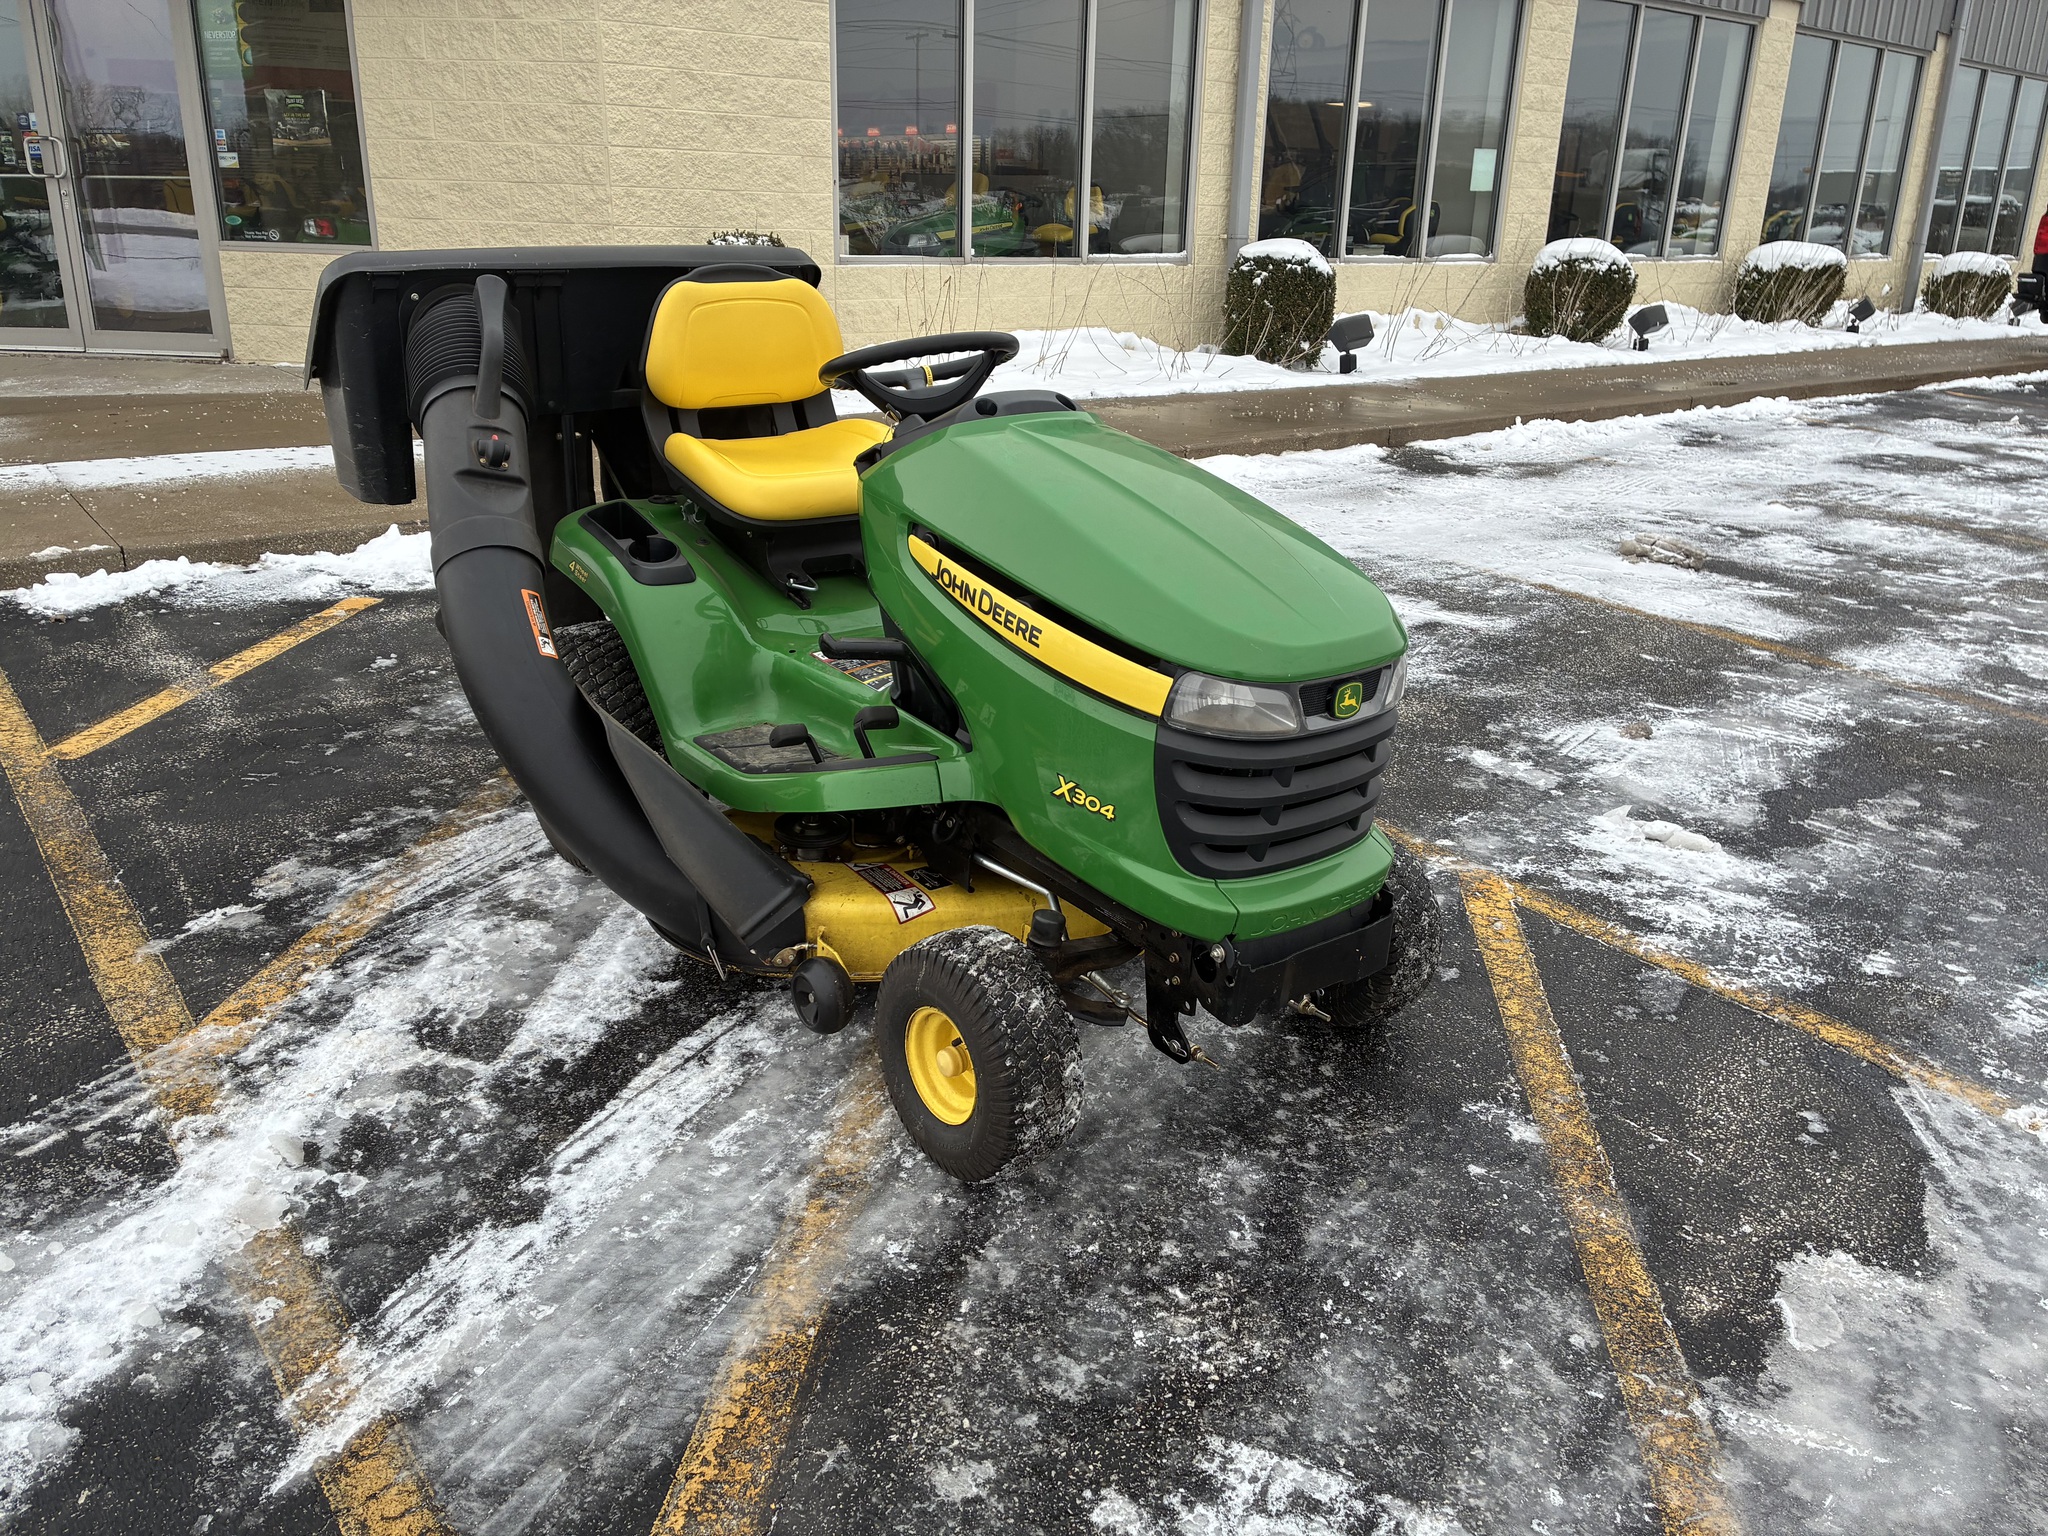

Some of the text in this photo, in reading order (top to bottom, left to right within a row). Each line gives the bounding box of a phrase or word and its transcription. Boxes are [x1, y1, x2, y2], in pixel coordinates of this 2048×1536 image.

[569, 560, 576, 571] 4
[931, 558, 1042, 648] JOHN DEERE
[1050, 772, 1116, 822] X304
[888, 870, 911, 886] DANGER
